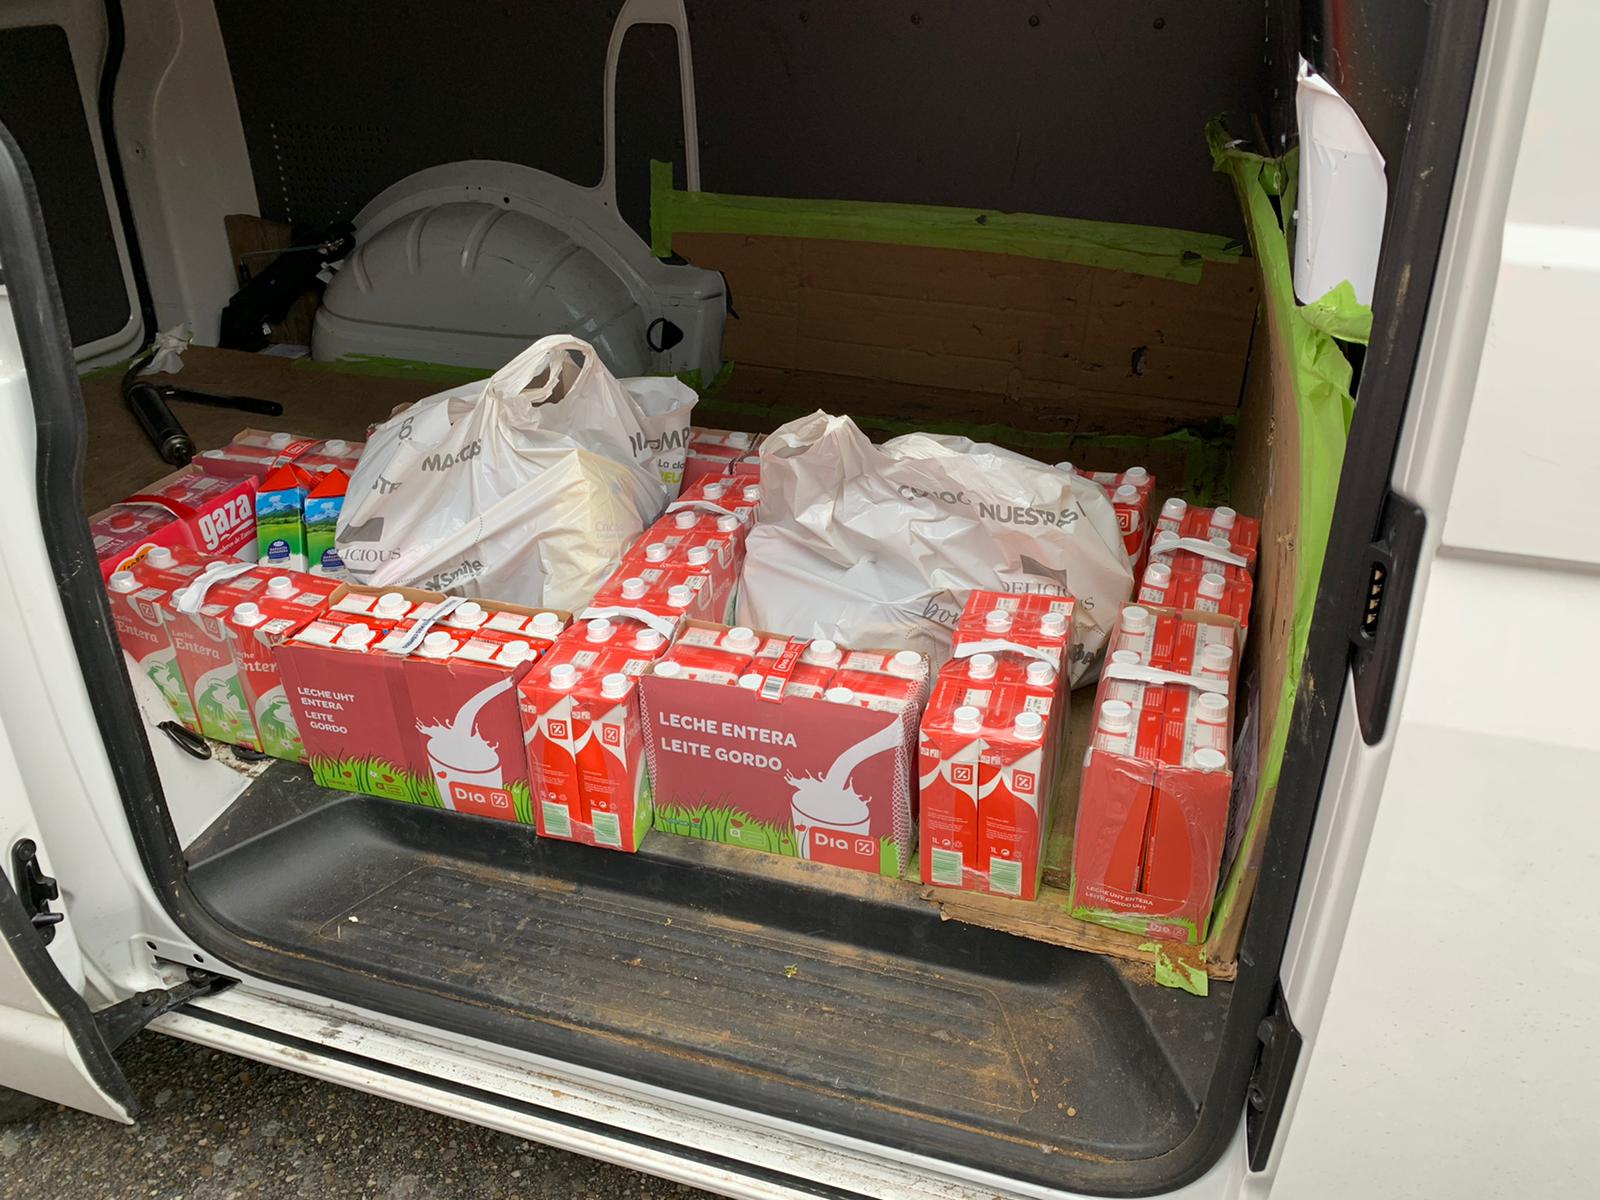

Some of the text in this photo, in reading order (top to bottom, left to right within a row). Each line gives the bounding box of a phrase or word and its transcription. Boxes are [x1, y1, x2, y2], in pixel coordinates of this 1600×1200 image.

[198, 494, 253, 551] gaza
[116, 621, 160, 644] Entera
[174, 637, 221, 660] Entera
[297, 686, 357, 704] LECHE UHT
[301, 697, 344, 712] ENTERA
[304, 710, 335, 723] LEITE
[310, 720, 348, 735] GORDO
[658, 711, 798, 749] LECHE ENTERA
[660, 736, 783, 772] LEITE GORDO
[454, 786, 486, 805] Dia
[815, 832, 849, 851] Dia
